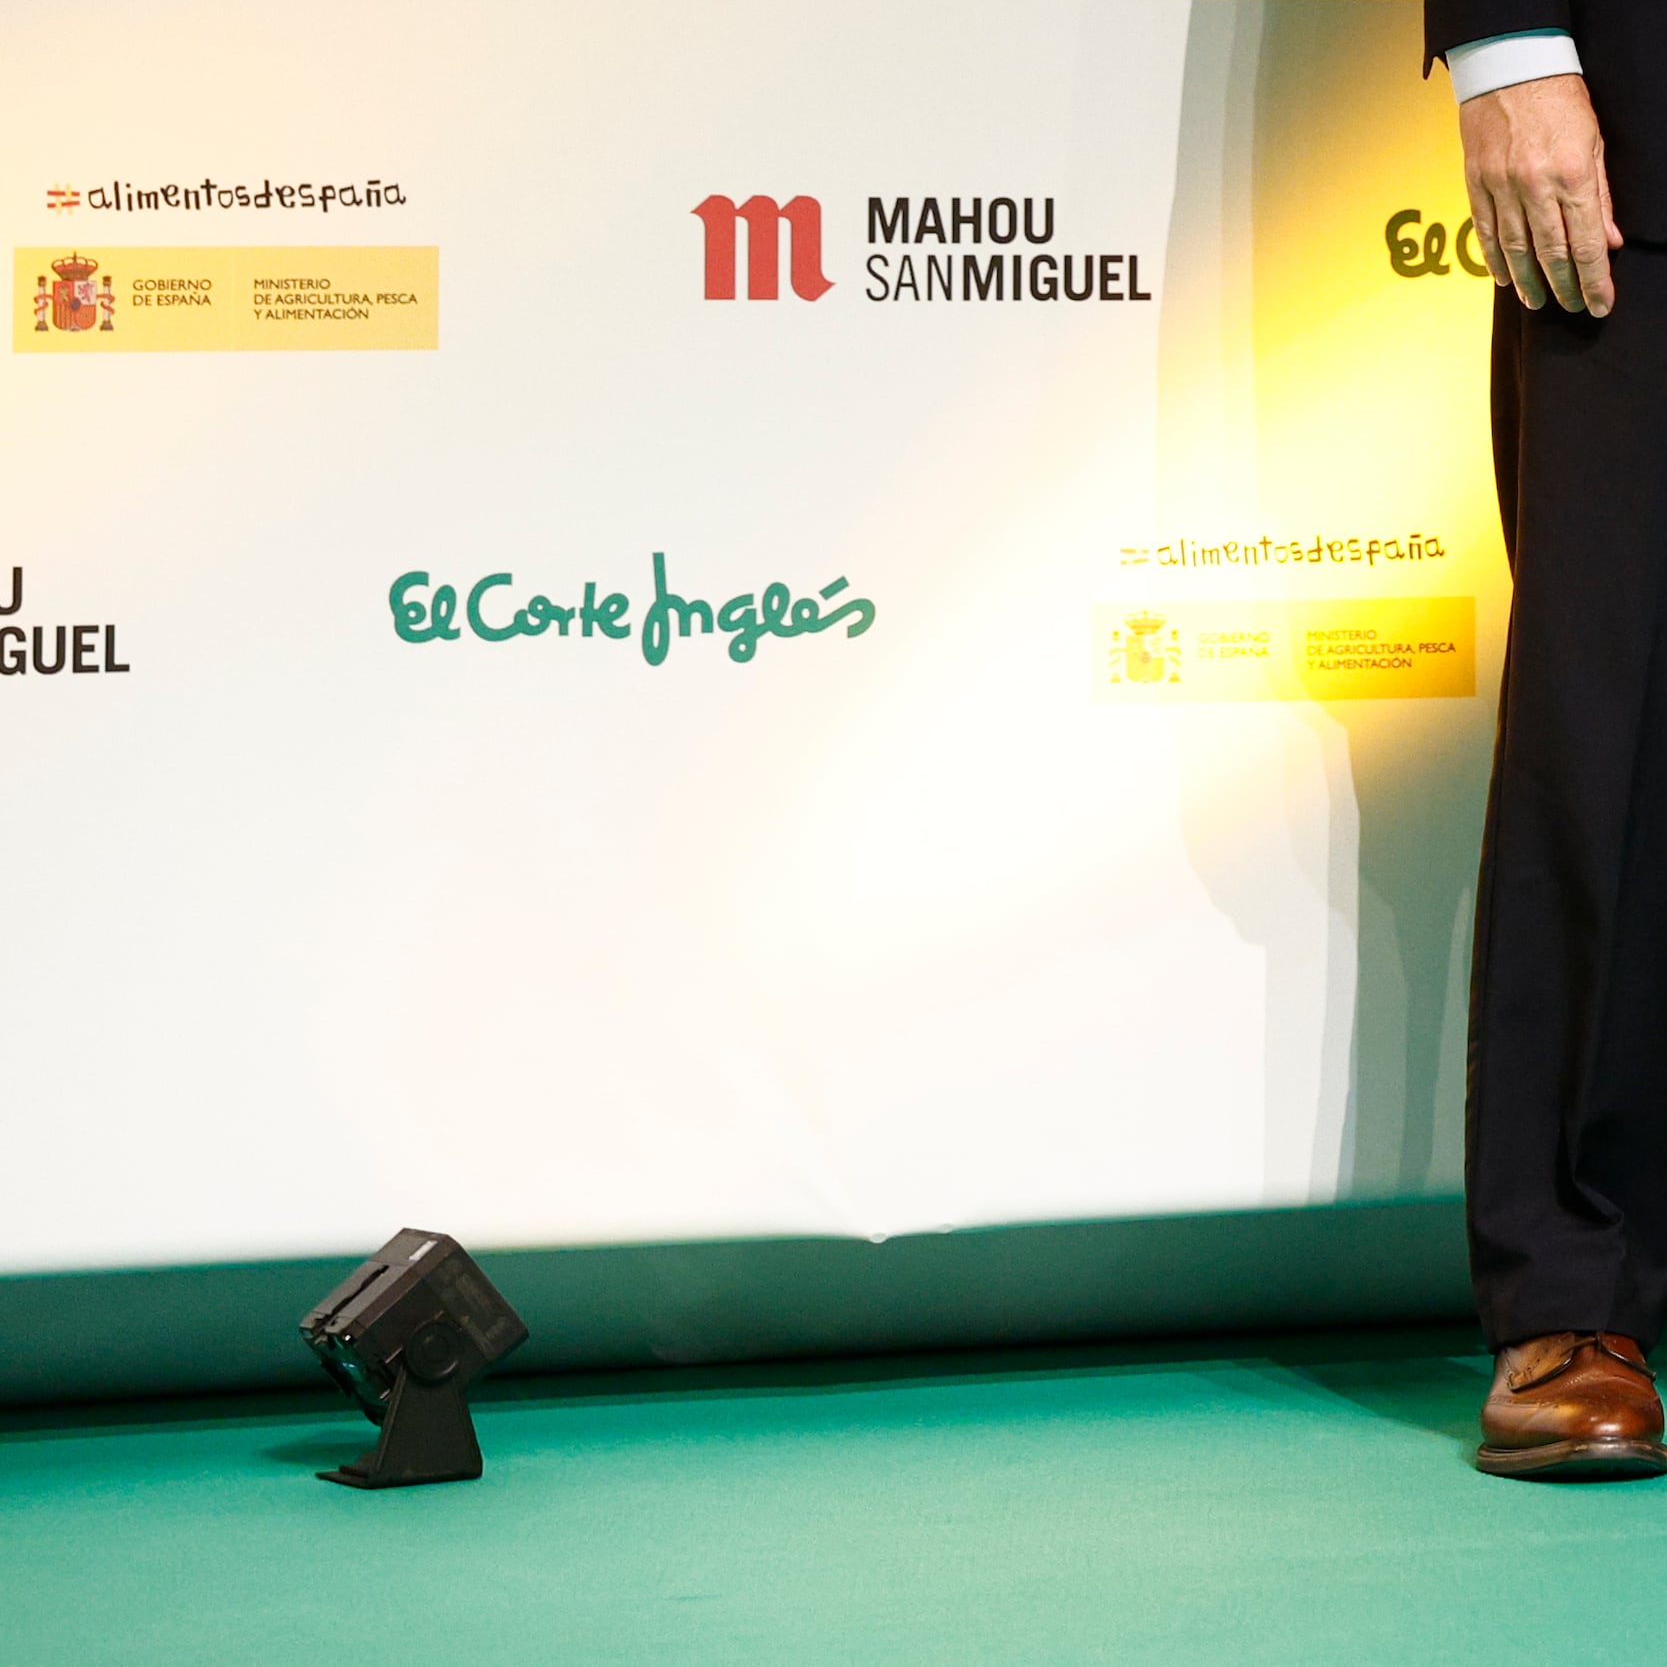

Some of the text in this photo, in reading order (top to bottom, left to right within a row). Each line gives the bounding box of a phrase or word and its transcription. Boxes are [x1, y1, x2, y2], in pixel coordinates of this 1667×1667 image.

[47, 179, 406, 214] #alimentosdespaña
[866, 196, 1056, 246] MAHOU
[1385, 209, 1450, 278] El
[132, 278, 213, 291] GOBIERNO
[253, 278, 331, 290] MINISTERIO
[865, 252, 1152, 303] SANMIGUEL
[132, 291, 212, 307] DE ESPAÑA
[253, 293, 271, 305] DE
[376, 293, 418, 305] PESCA
[253, 307, 370, 320] Y ALIMENTACIÓN
[389, 551, 877, 667] El Corte Inglés
[1306, 630, 1377, 642] MINISTERIO
[1306, 644, 1324, 657] DE
[1418, 641, 1456, 654] PESCA
[1307, 656, 1413, 670] Y ALIMENTACIÓN
